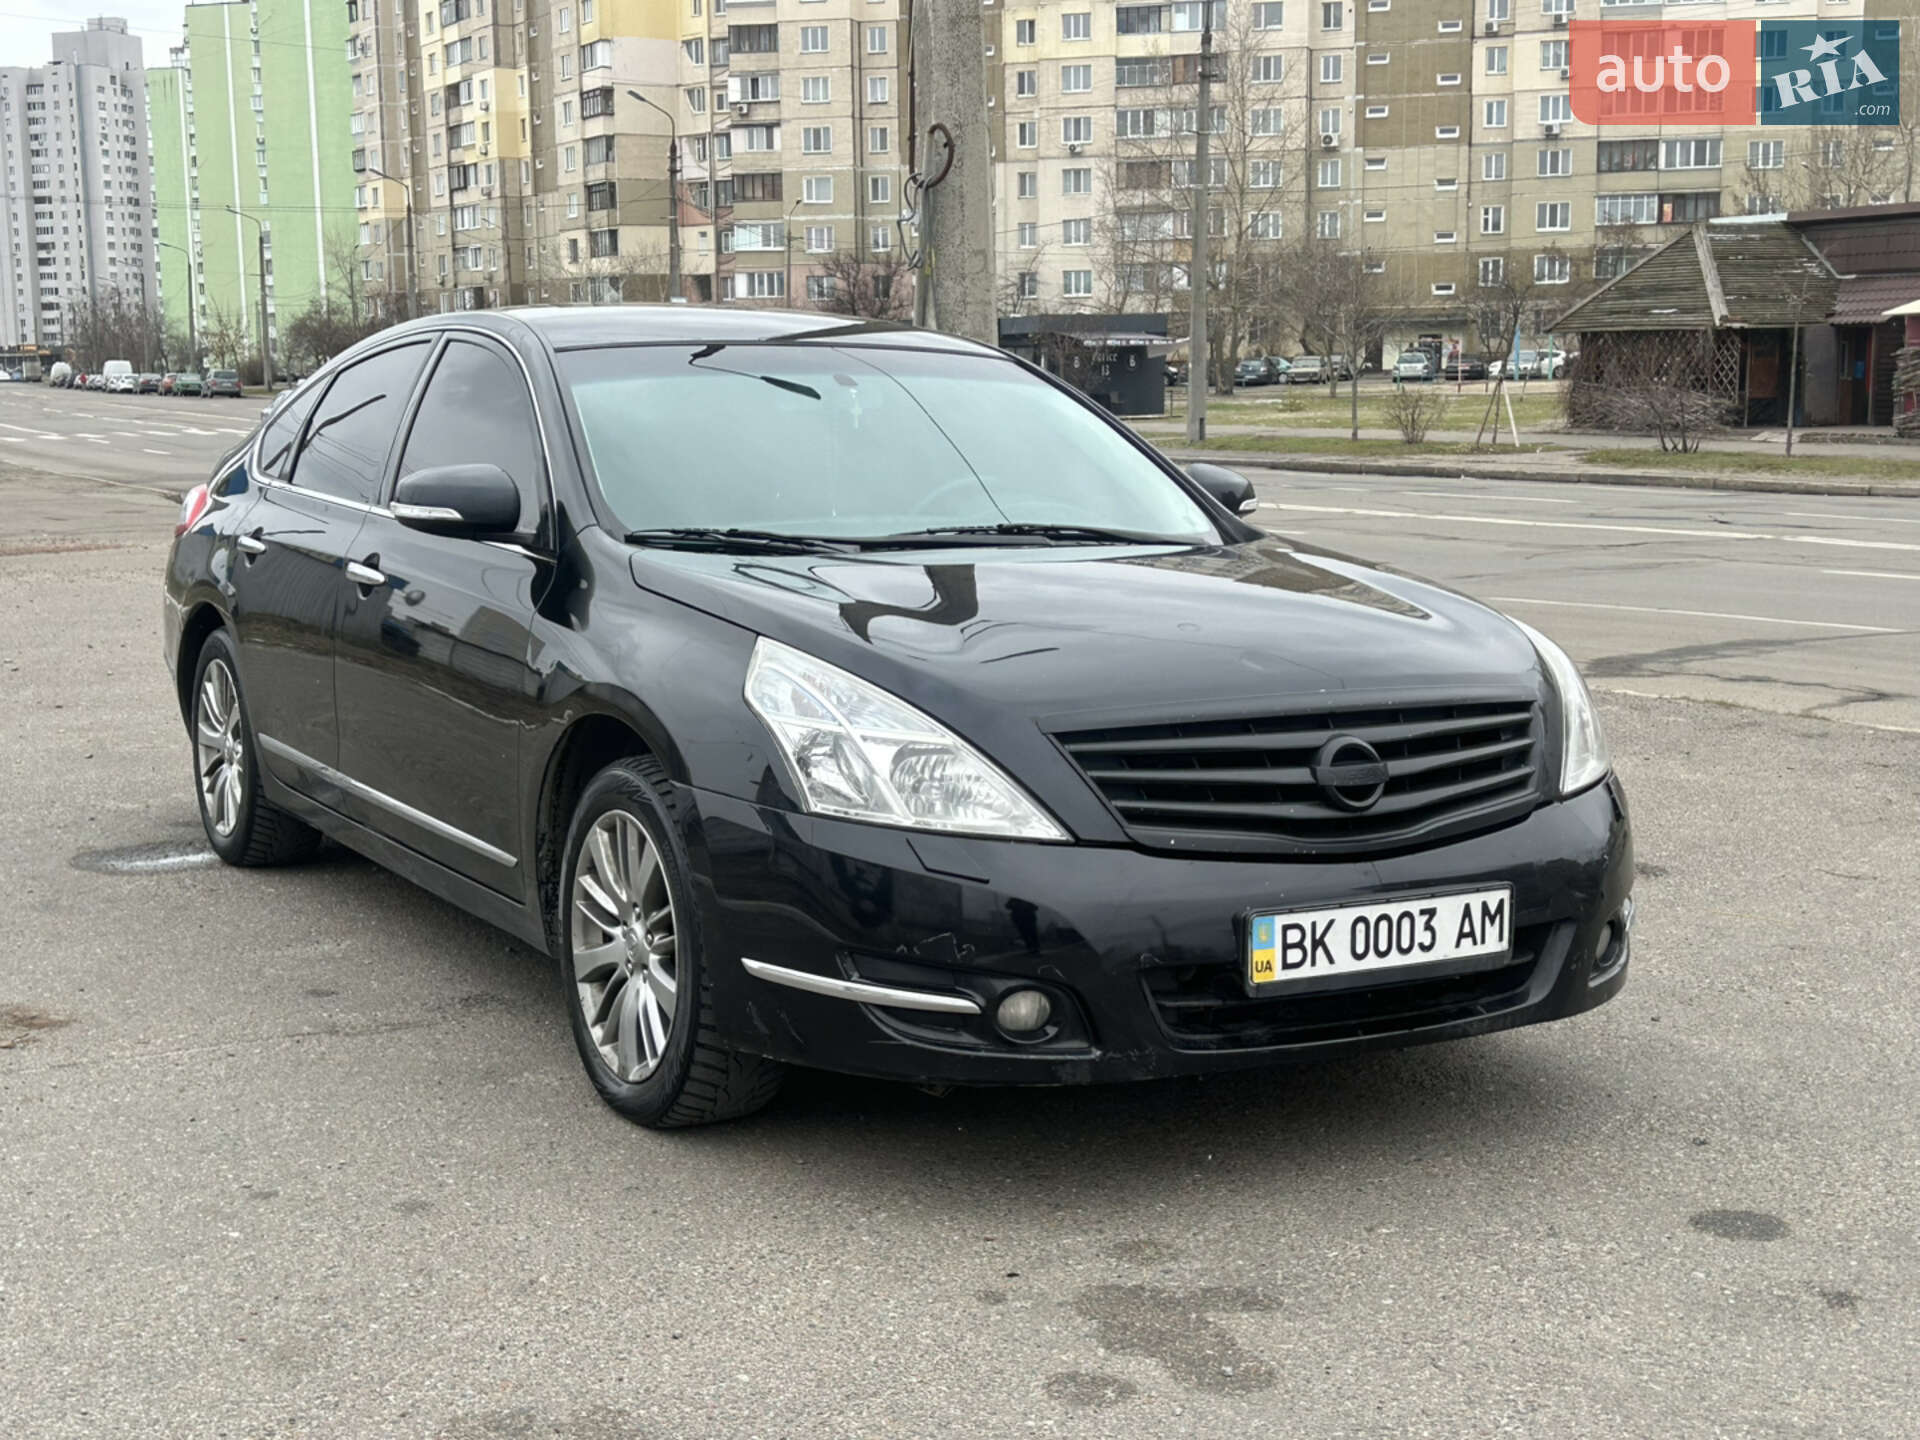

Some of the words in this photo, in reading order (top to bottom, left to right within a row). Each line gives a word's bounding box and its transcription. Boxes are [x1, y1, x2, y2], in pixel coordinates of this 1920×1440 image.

[1281, 918, 1336, 970] BK
[1351, 907, 1437, 961] 0003
[1455, 898, 1504, 949] AM
[1255, 959, 1273, 973] UA
